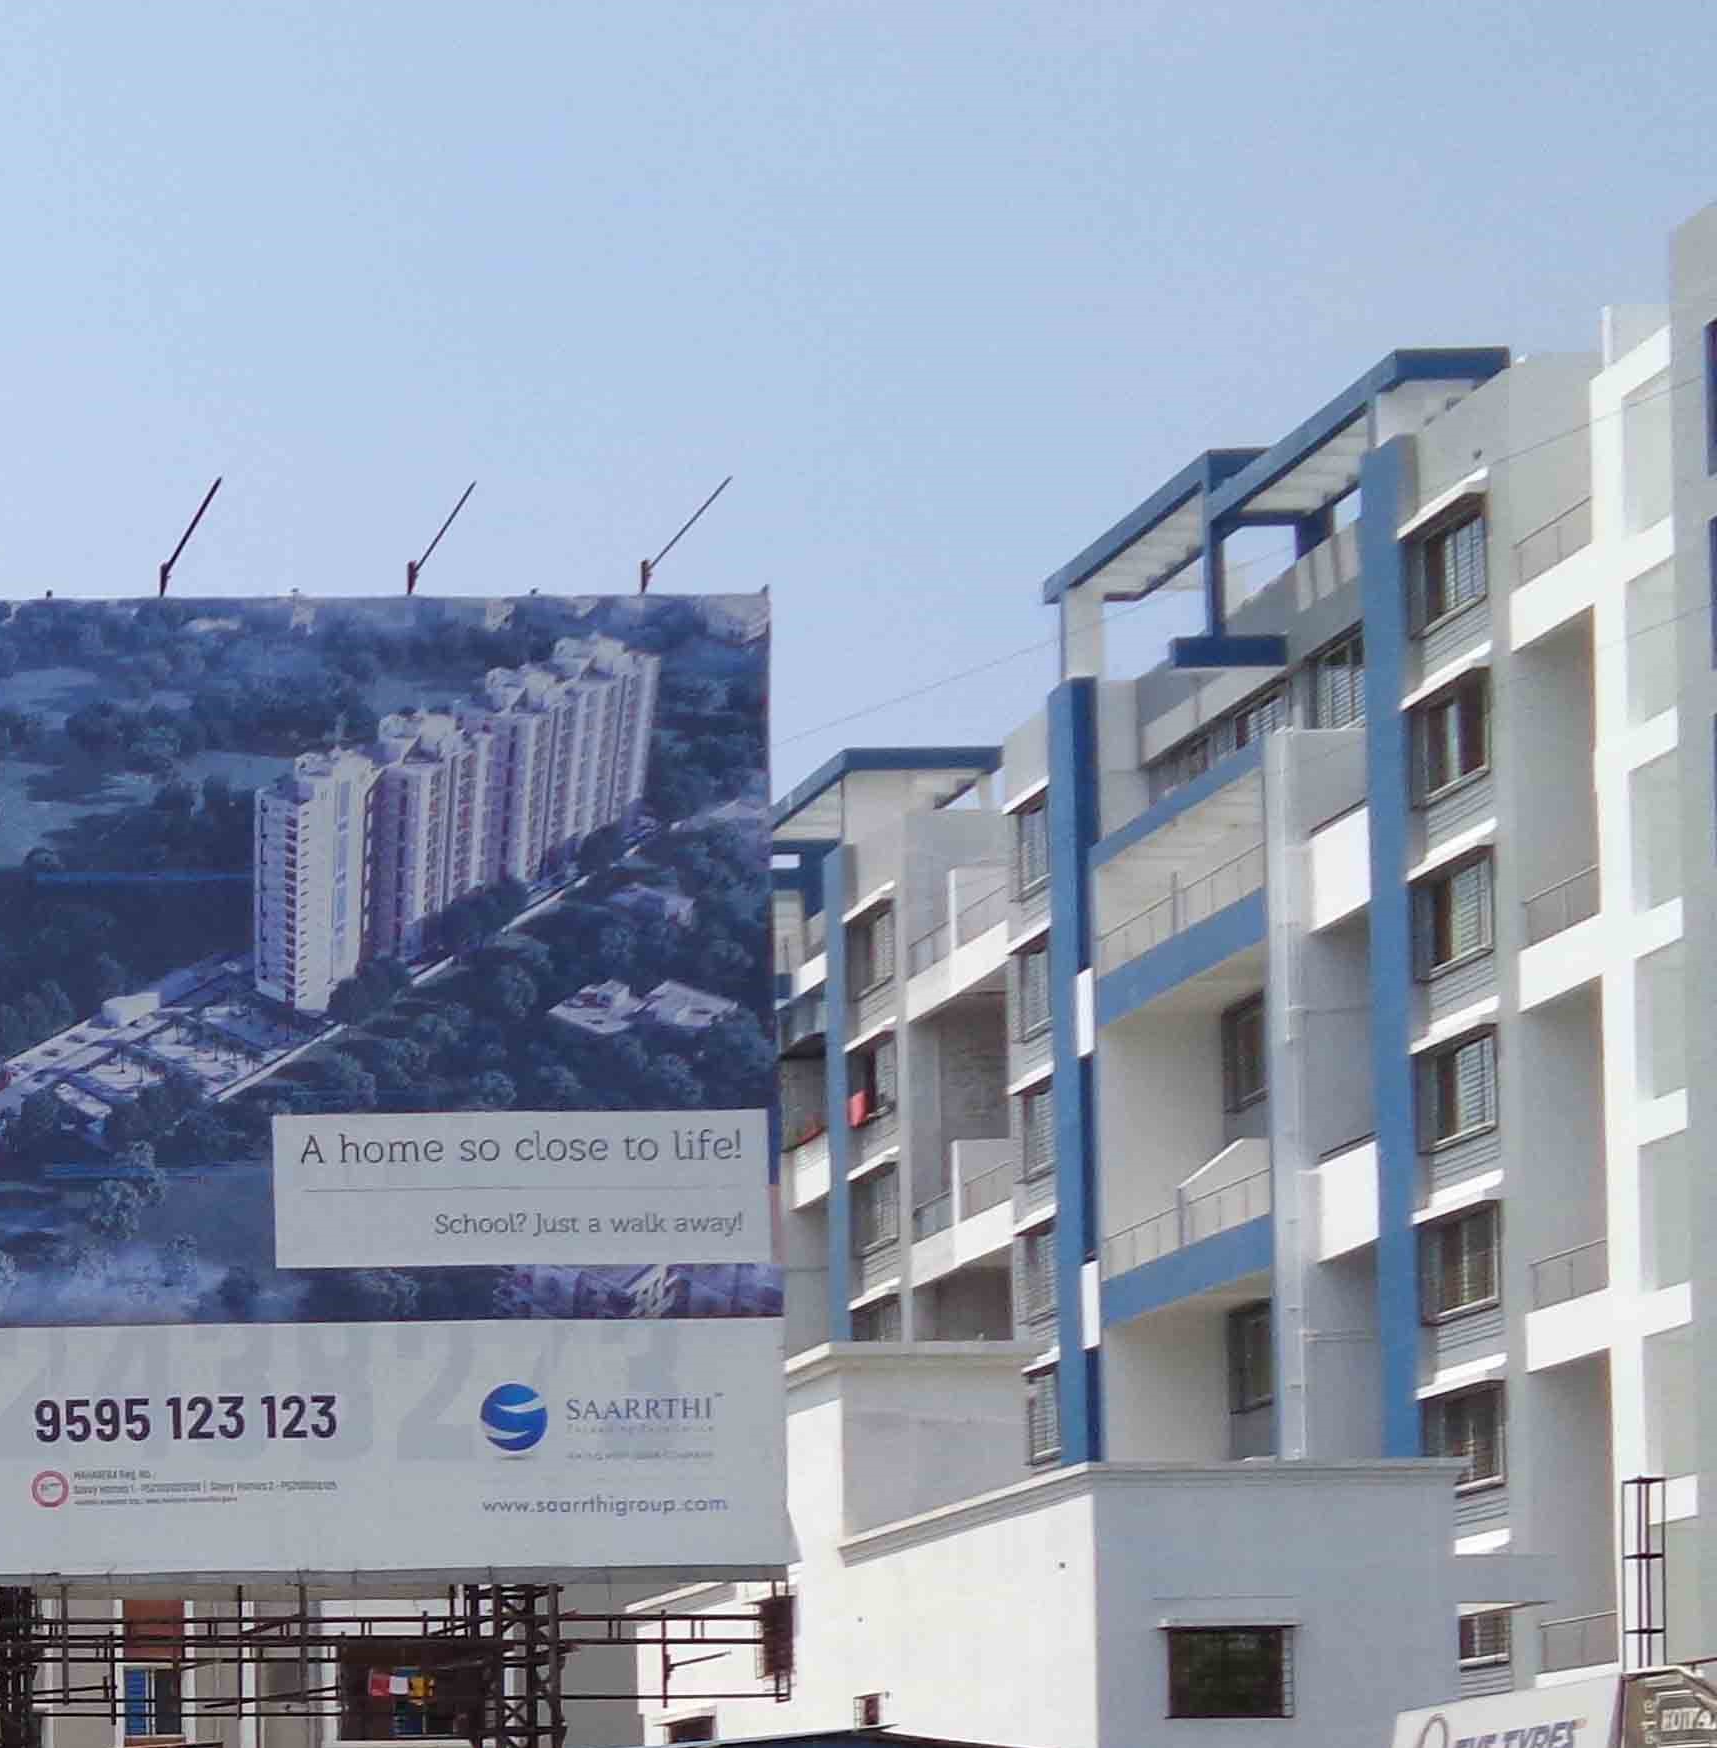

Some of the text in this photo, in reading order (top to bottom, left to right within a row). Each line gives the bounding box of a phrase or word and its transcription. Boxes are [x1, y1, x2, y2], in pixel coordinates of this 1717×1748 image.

[300, 1129, 742, 1165] A home so close to life!
[434, 1211, 744, 1237] School? Just a walk away!
[34, 1395, 337, 1443] 9595 123 123
[566, 1397, 713, 1421] SAARRTHI
[482, 1495, 729, 1516] www.saarrthigroup.com
